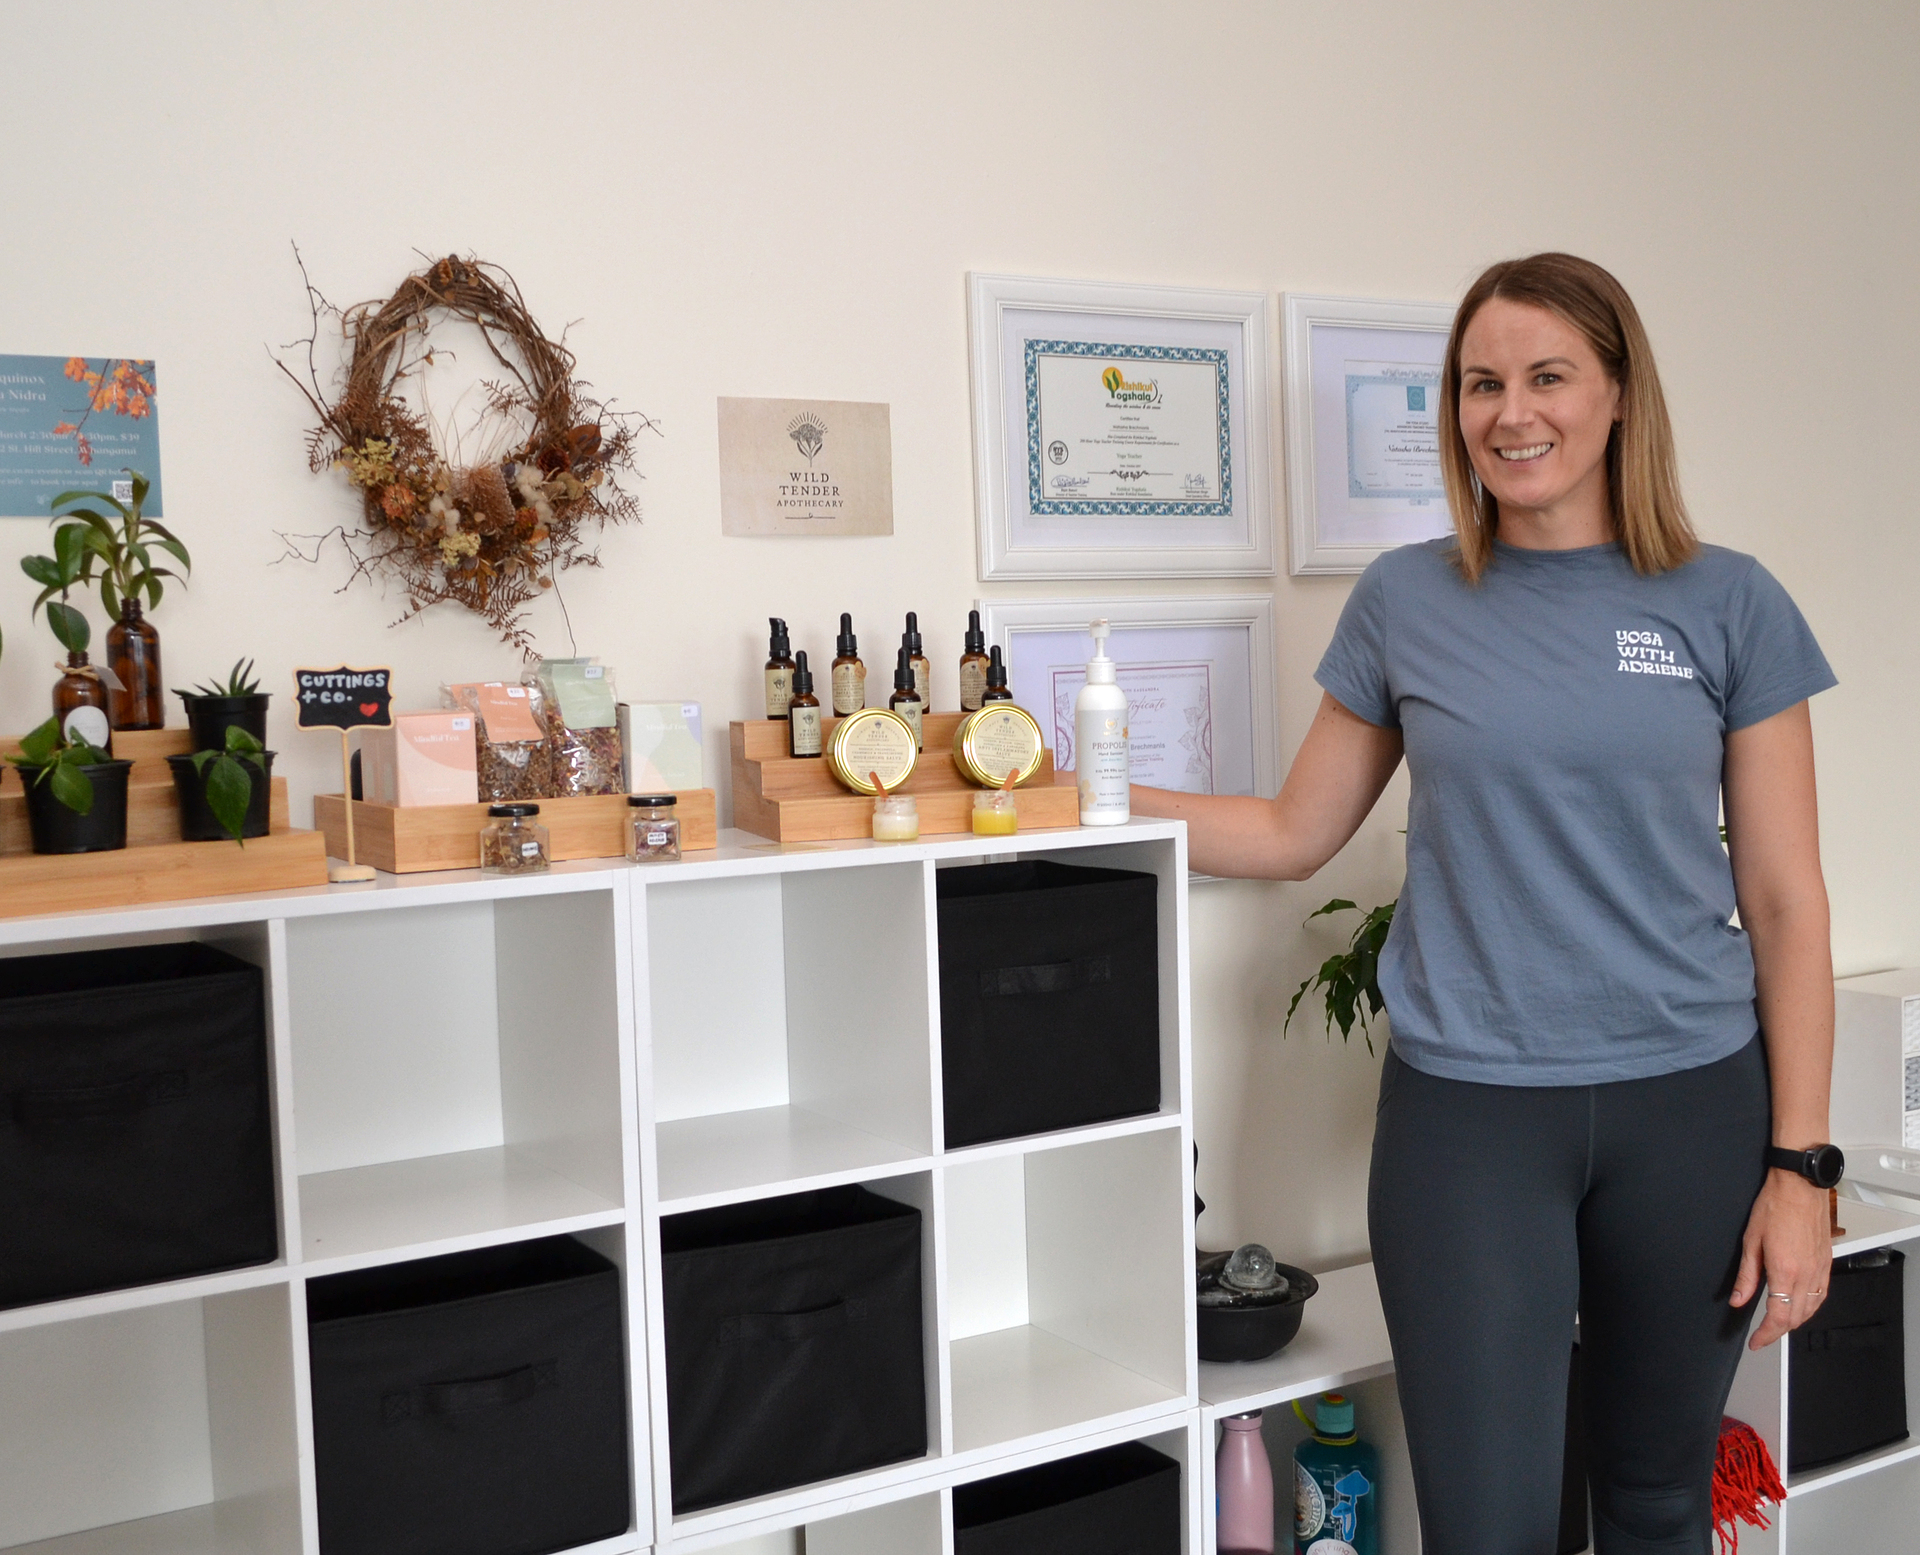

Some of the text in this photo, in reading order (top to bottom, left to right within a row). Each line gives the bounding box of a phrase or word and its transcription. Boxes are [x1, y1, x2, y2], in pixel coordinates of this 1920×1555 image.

[9, 389, 46, 400] Nidra
[790, 472, 830, 483] WILD
[779, 485, 841, 496] TENDER
[776, 499, 844, 508] APOTHECARY
[1615, 630, 1663, 647] YOGA
[1617, 645, 1675, 664] WITH
[1617, 659, 1693, 680] ADRIENE
[301, 672, 386, 689] CUTTINGS
[320, 690, 353, 704] CO.
[413, 733, 460, 743] Mindful Tea
